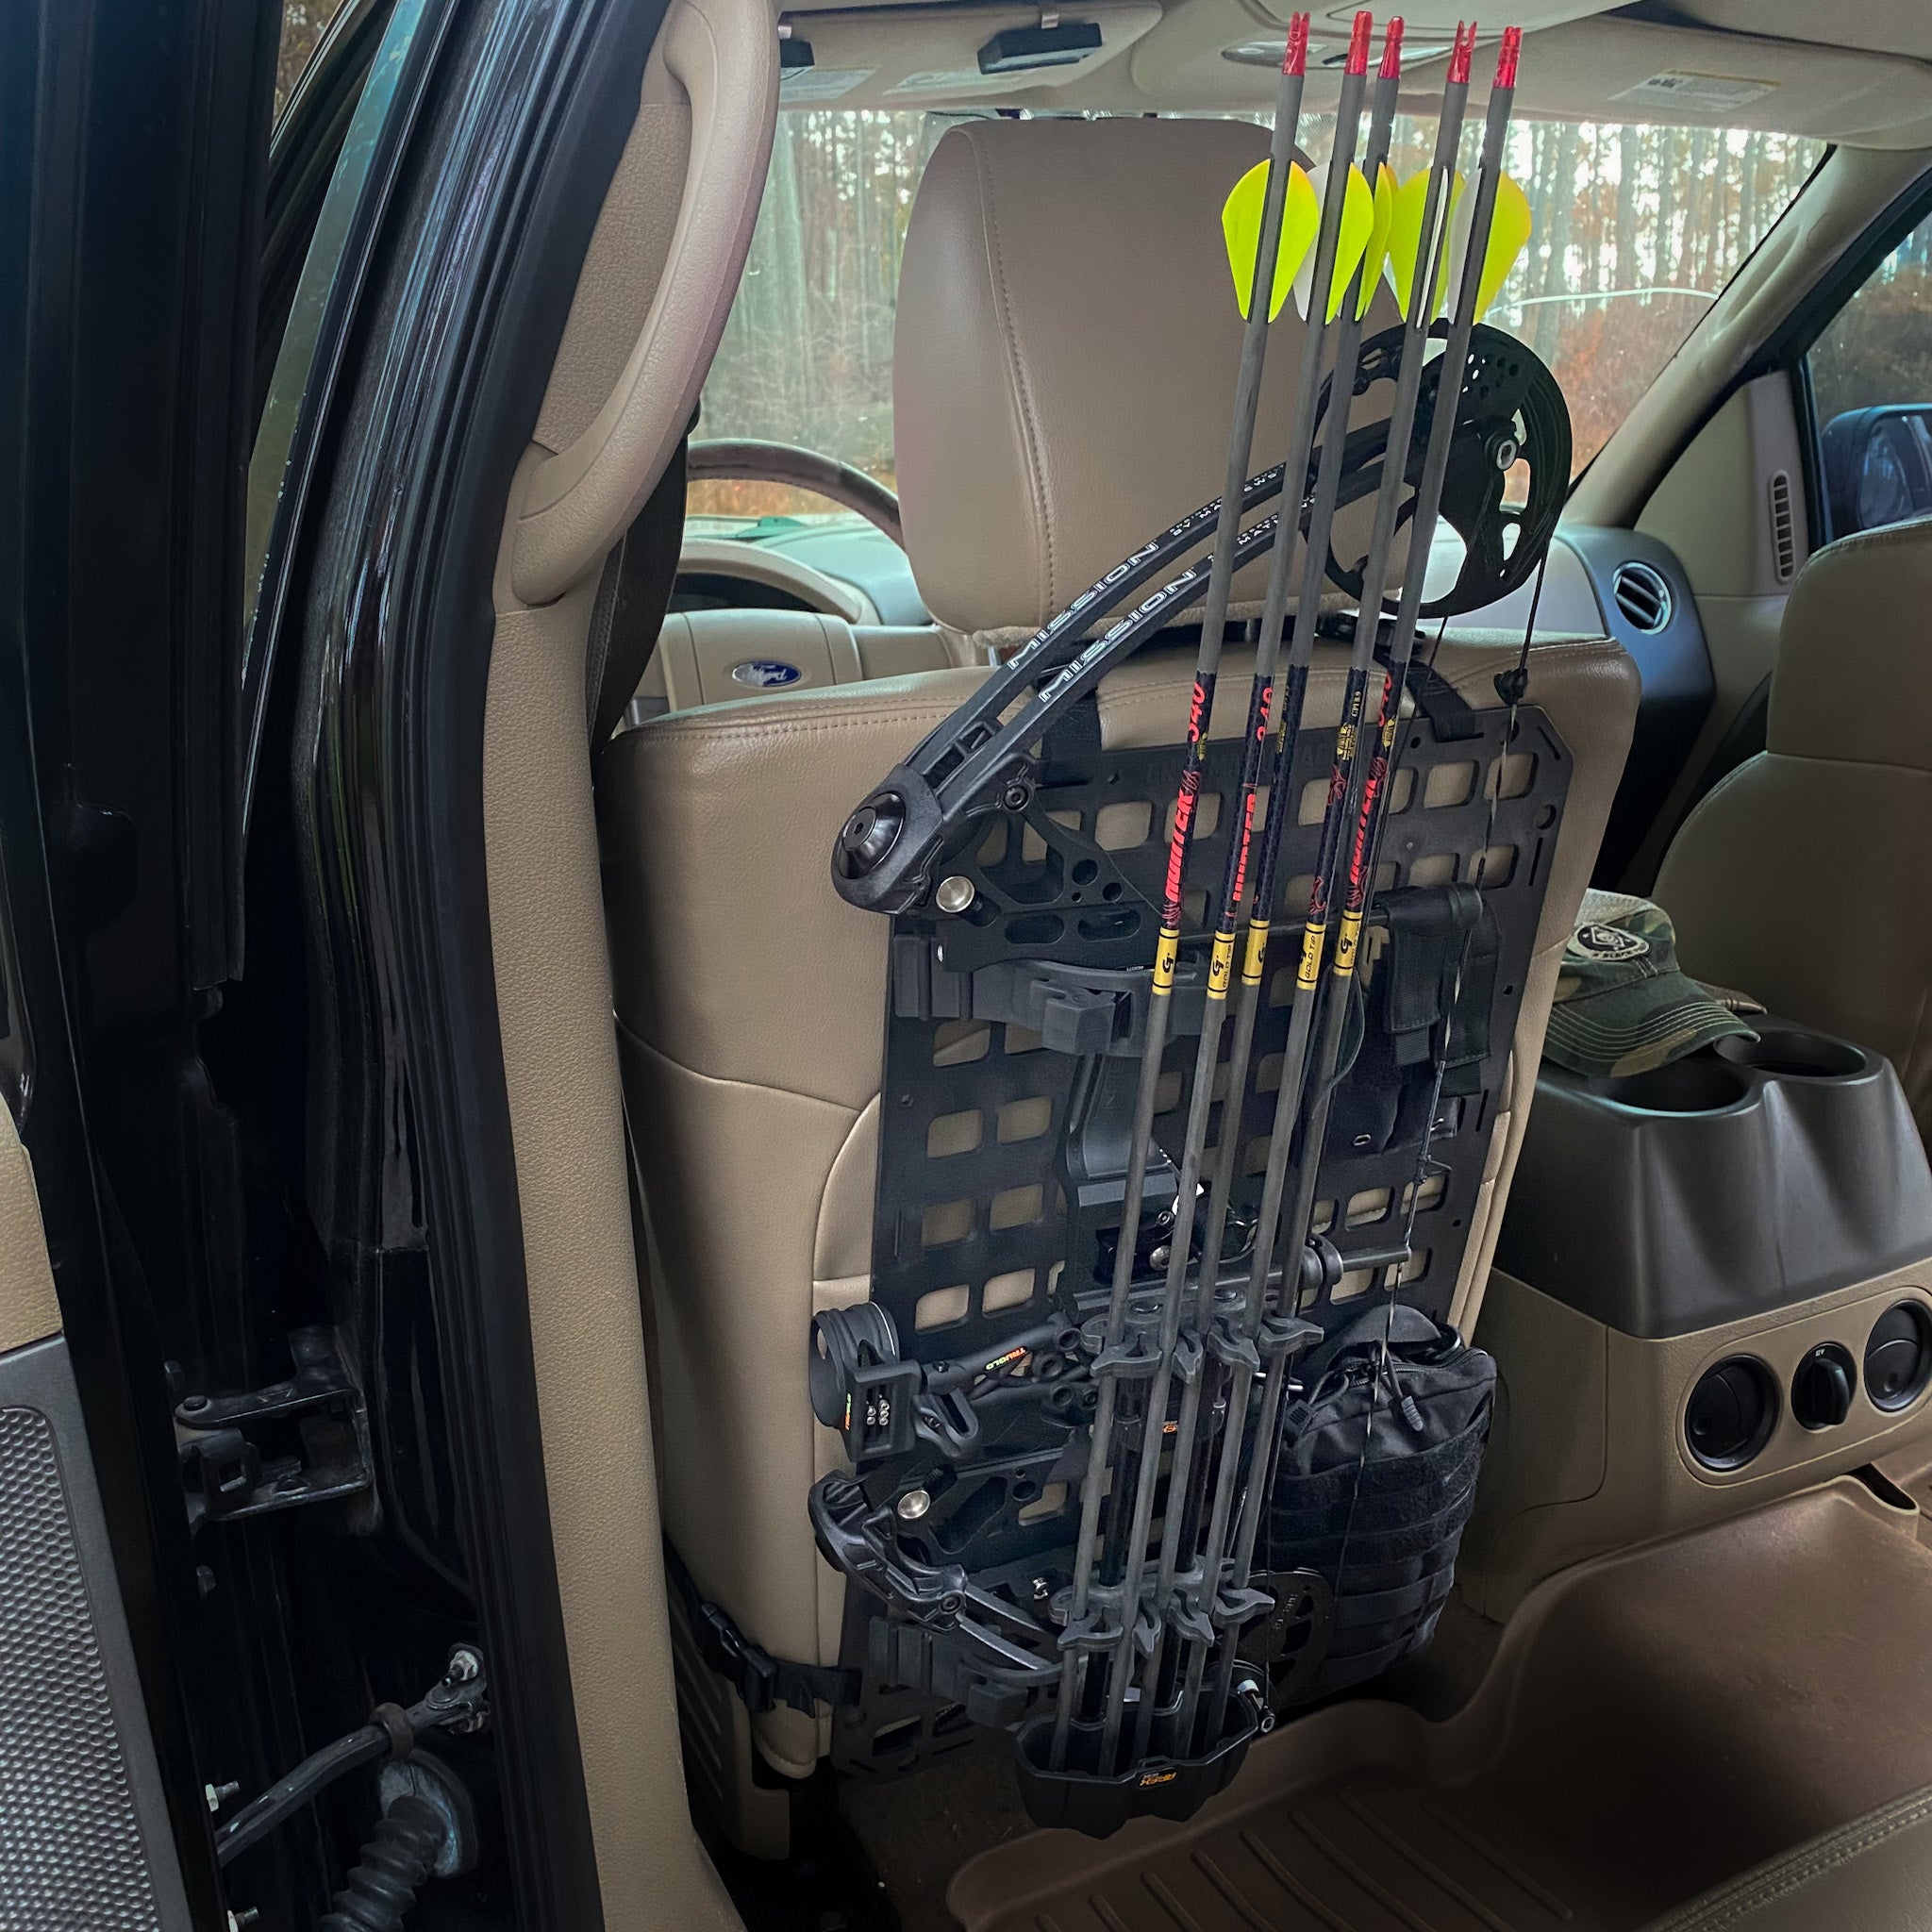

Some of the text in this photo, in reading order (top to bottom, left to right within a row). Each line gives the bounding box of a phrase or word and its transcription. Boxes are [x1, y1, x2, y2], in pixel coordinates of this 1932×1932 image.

[1008, 541, 1158, 671] MISSION
[1039, 568, 1197, 702] MISSION
[1305, 952, 1314, 979] GOLD
